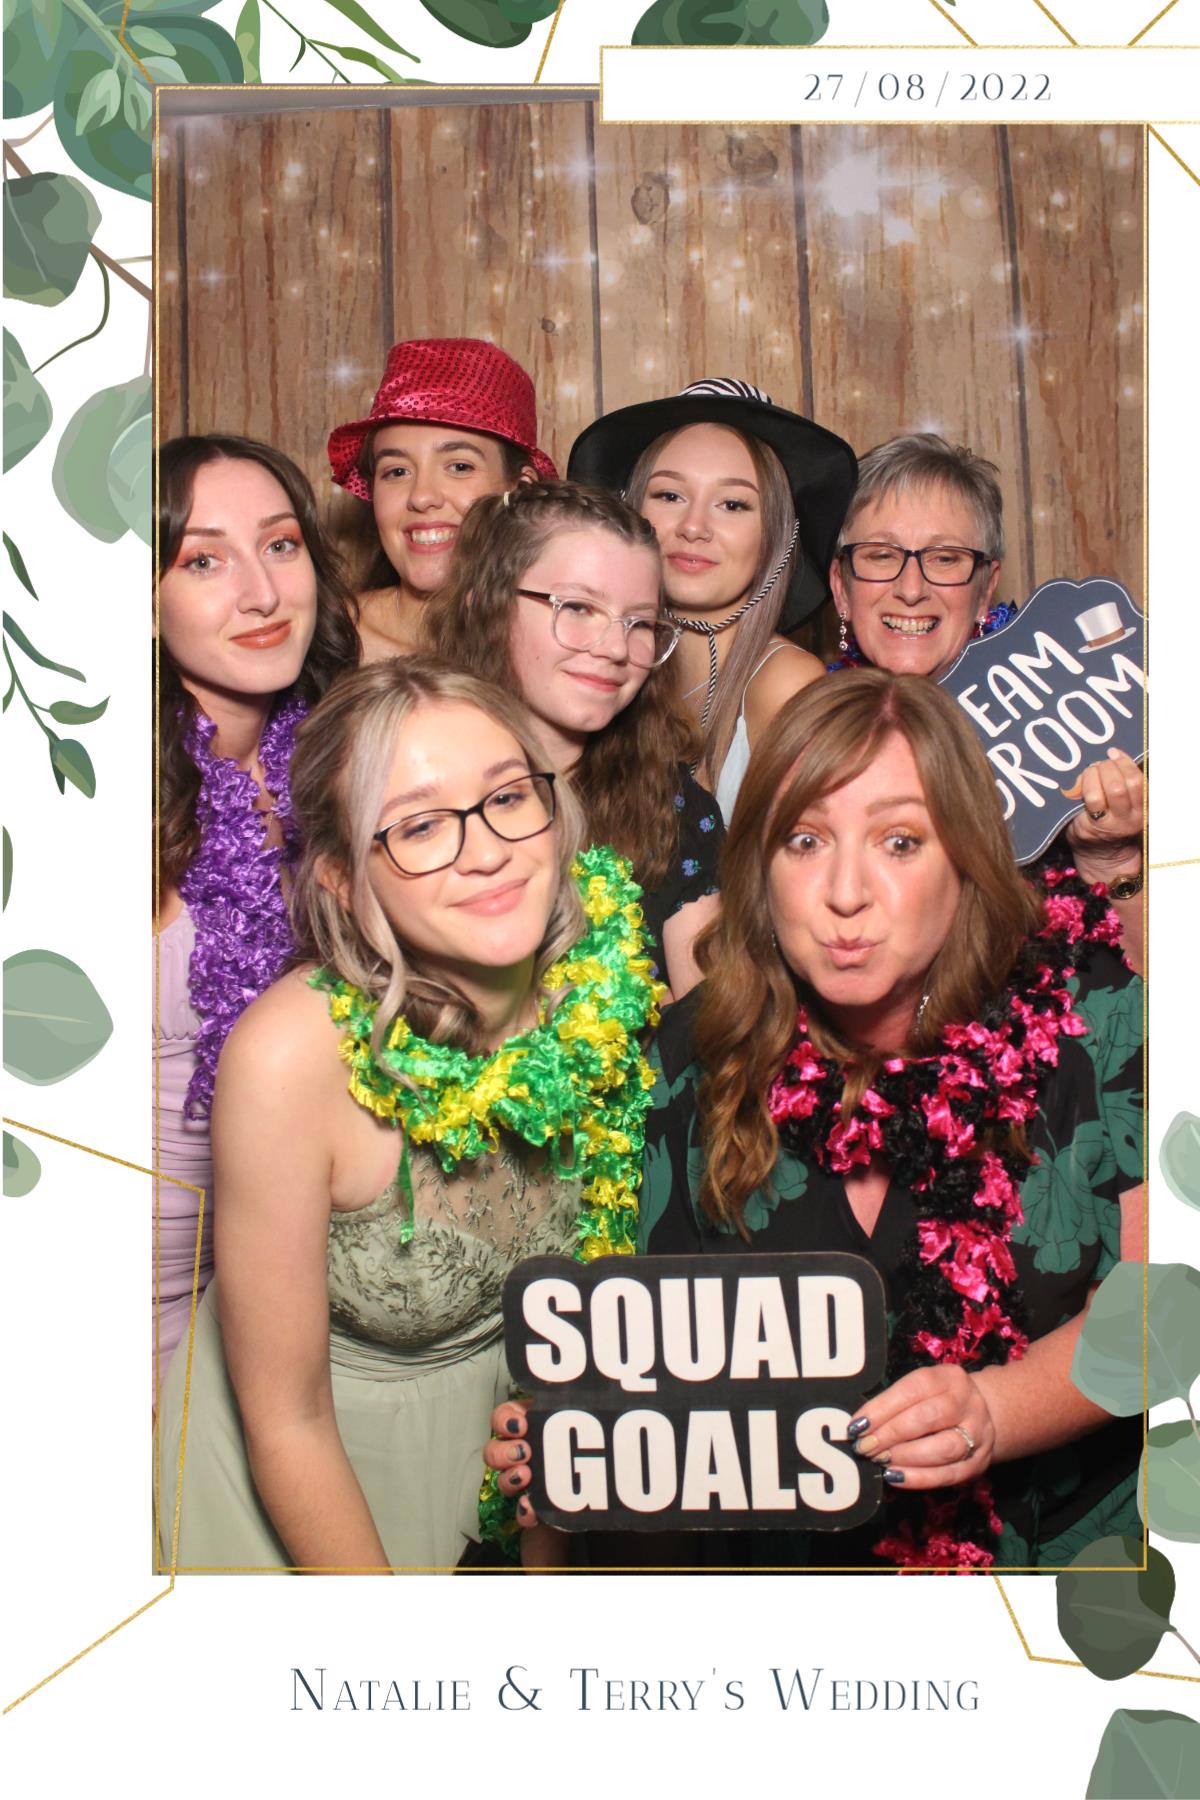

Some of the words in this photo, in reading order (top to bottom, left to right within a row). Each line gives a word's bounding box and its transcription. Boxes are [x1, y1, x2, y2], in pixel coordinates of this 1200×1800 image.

[957, 631, 1085, 738] EAM
[521, 1275, 866, 1392] SQUAD
[542, 1407, 861, 1512] GOALS
